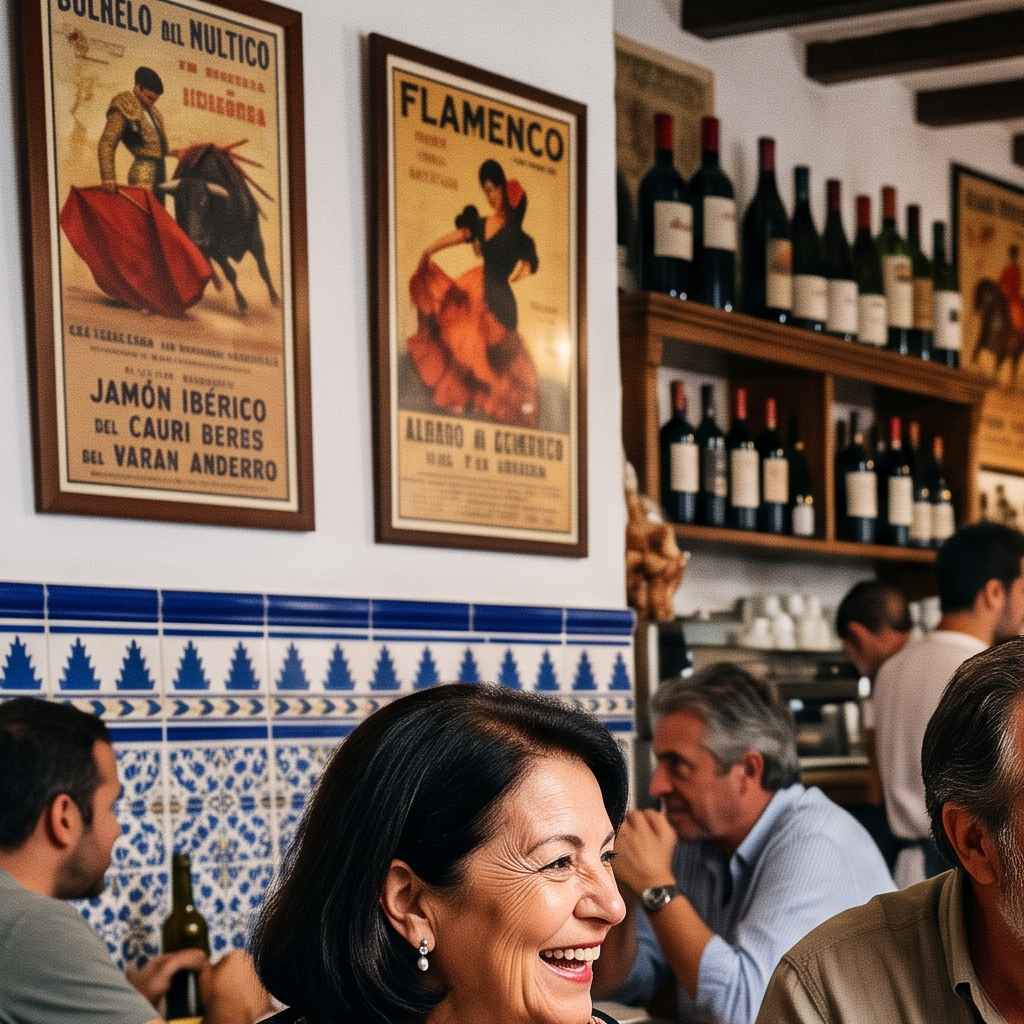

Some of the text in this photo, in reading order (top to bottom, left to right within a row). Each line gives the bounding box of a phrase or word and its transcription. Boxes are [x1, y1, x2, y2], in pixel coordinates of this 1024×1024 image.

[189, 19, 270, 70] NULTICO
[400, 80, 565, 162] FLAMENCO
[90, 378, 171, 412] JAMÓN
[182, 386, 267, 423] IBÉRICO
[129, 415, 191, 443] CAURI
[201, 423, 264, 452] BERES
[113, 444, 179, 472] VARAN
[189, 452, 278, 482] ANDERRO
